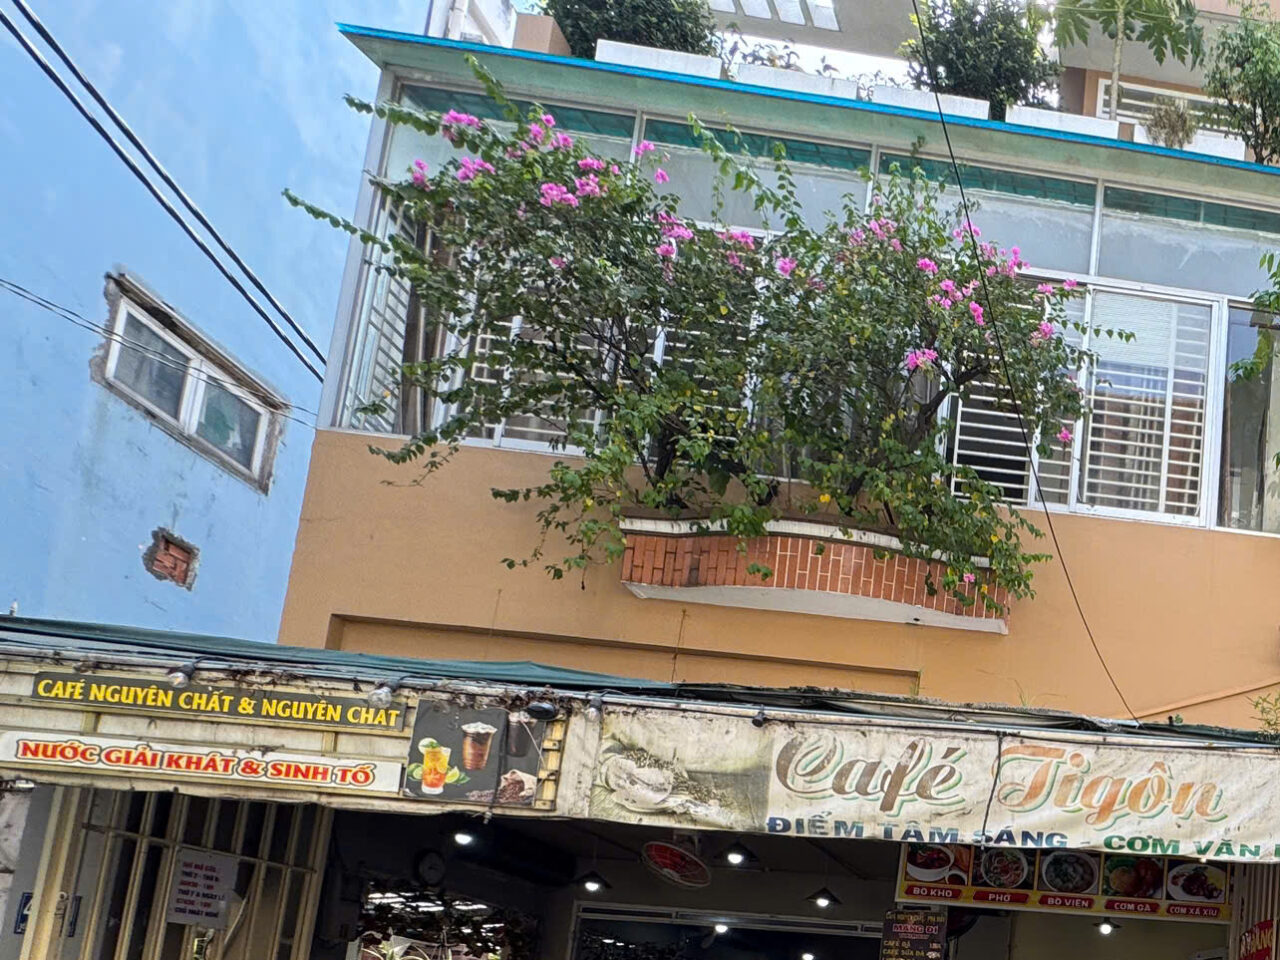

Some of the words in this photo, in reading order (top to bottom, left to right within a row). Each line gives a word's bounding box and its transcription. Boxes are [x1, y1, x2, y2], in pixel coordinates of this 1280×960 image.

[37, 678, 86, 700] CAFÉ
[88, 684, 174, 708] NGUYÊN
[178, 689, 234, 713] CHẤT
[237, 696, 257, 715] &
[261, 699, 343, 722] NGUYÊN
[18, 740, 99, 763] NƯỚC
[103, 745, 159, 767] GIẢI
[164, 752, 236, 774] KHÁT
[240, 759, 264, 775] &
[269, 762, 331, 782] SINH
[336, 764, 374, 785] TỐ
[776, 731, 967, 818] Café
[991, 743, 1228, 831] Tigôn
[767, 811, 864, 838] ĐIỂM
[878, 820, 959, 843] TÂM
[972, 826, 1069, 848] SÁNG
[1103, 835, 1181, 855] CƠM
[1193, 839, 1260, 858] VĂN
[930, 888, 952, 898] KHO
